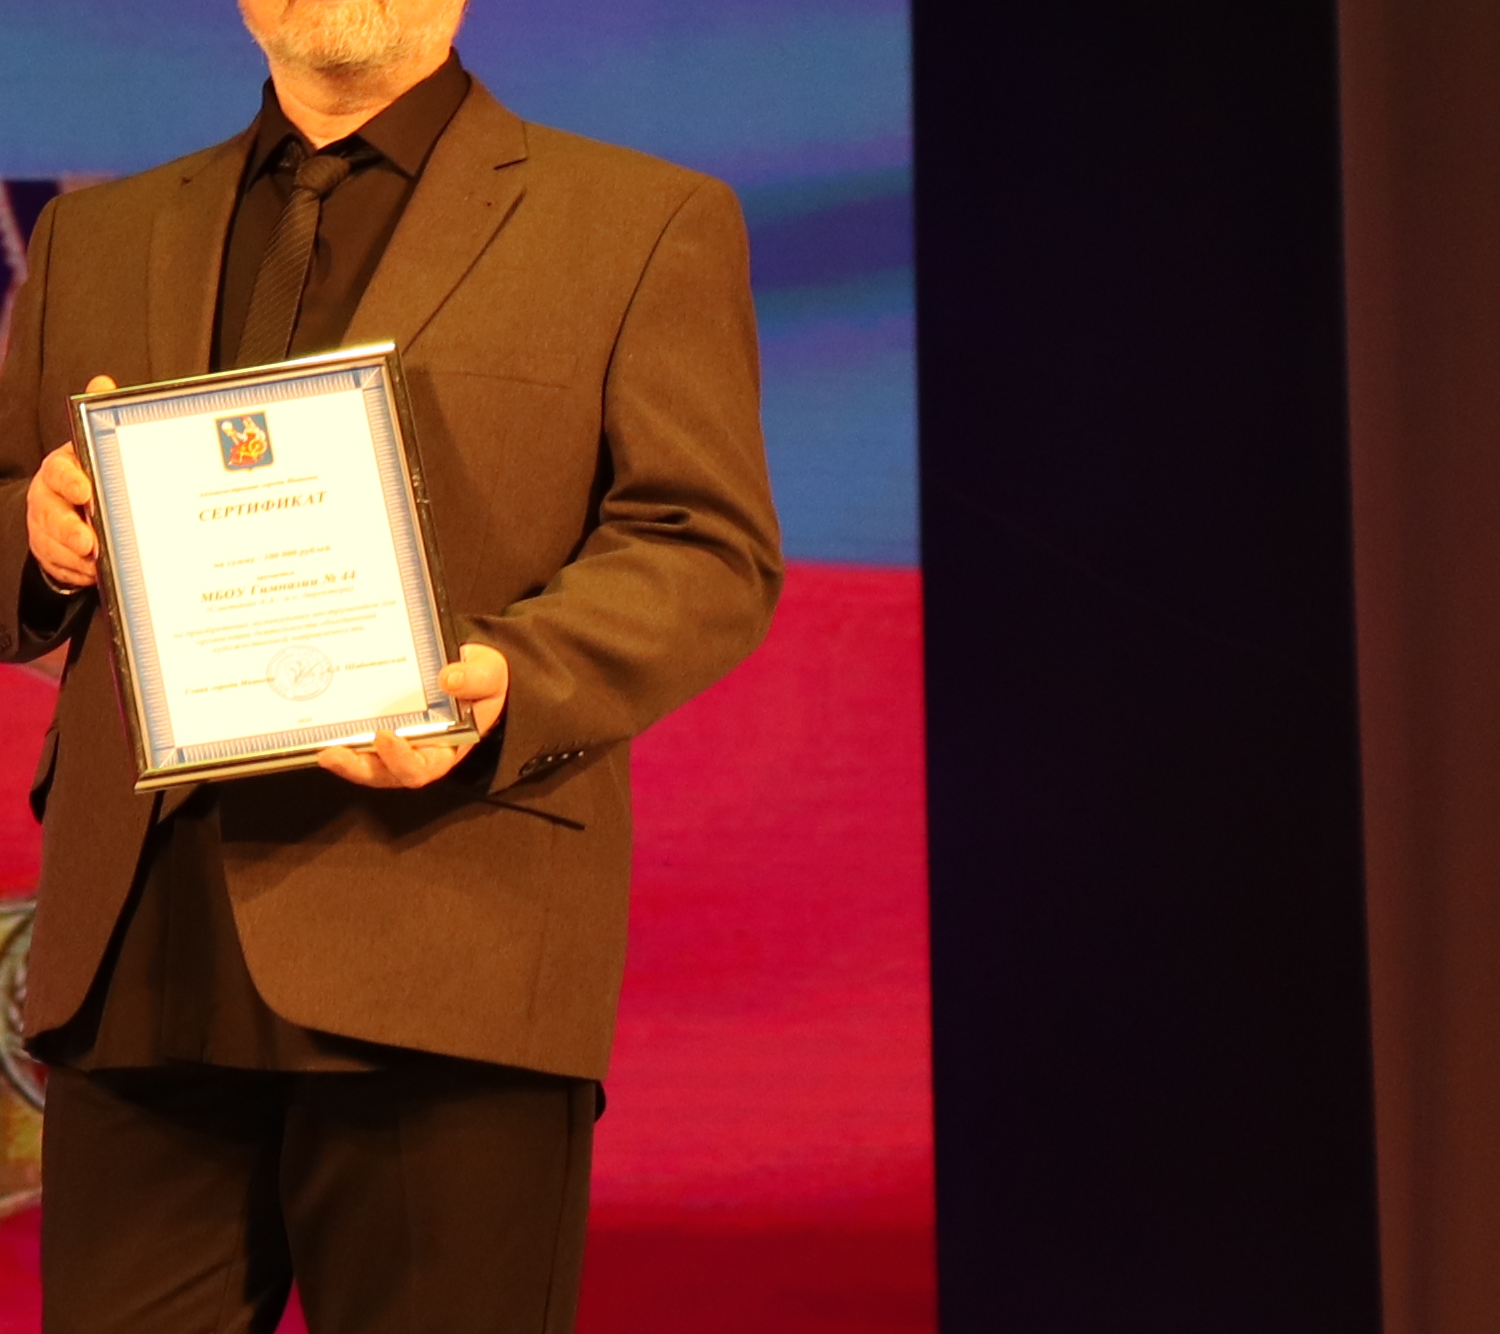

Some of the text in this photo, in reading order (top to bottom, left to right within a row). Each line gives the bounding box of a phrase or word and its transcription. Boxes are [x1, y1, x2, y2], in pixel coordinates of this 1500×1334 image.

[198, 491, 326, 521] СЕРТИФИКАТ
[201, 587, 244, 600] МБОУ
[250, 579, 318, 594] Гимназии
